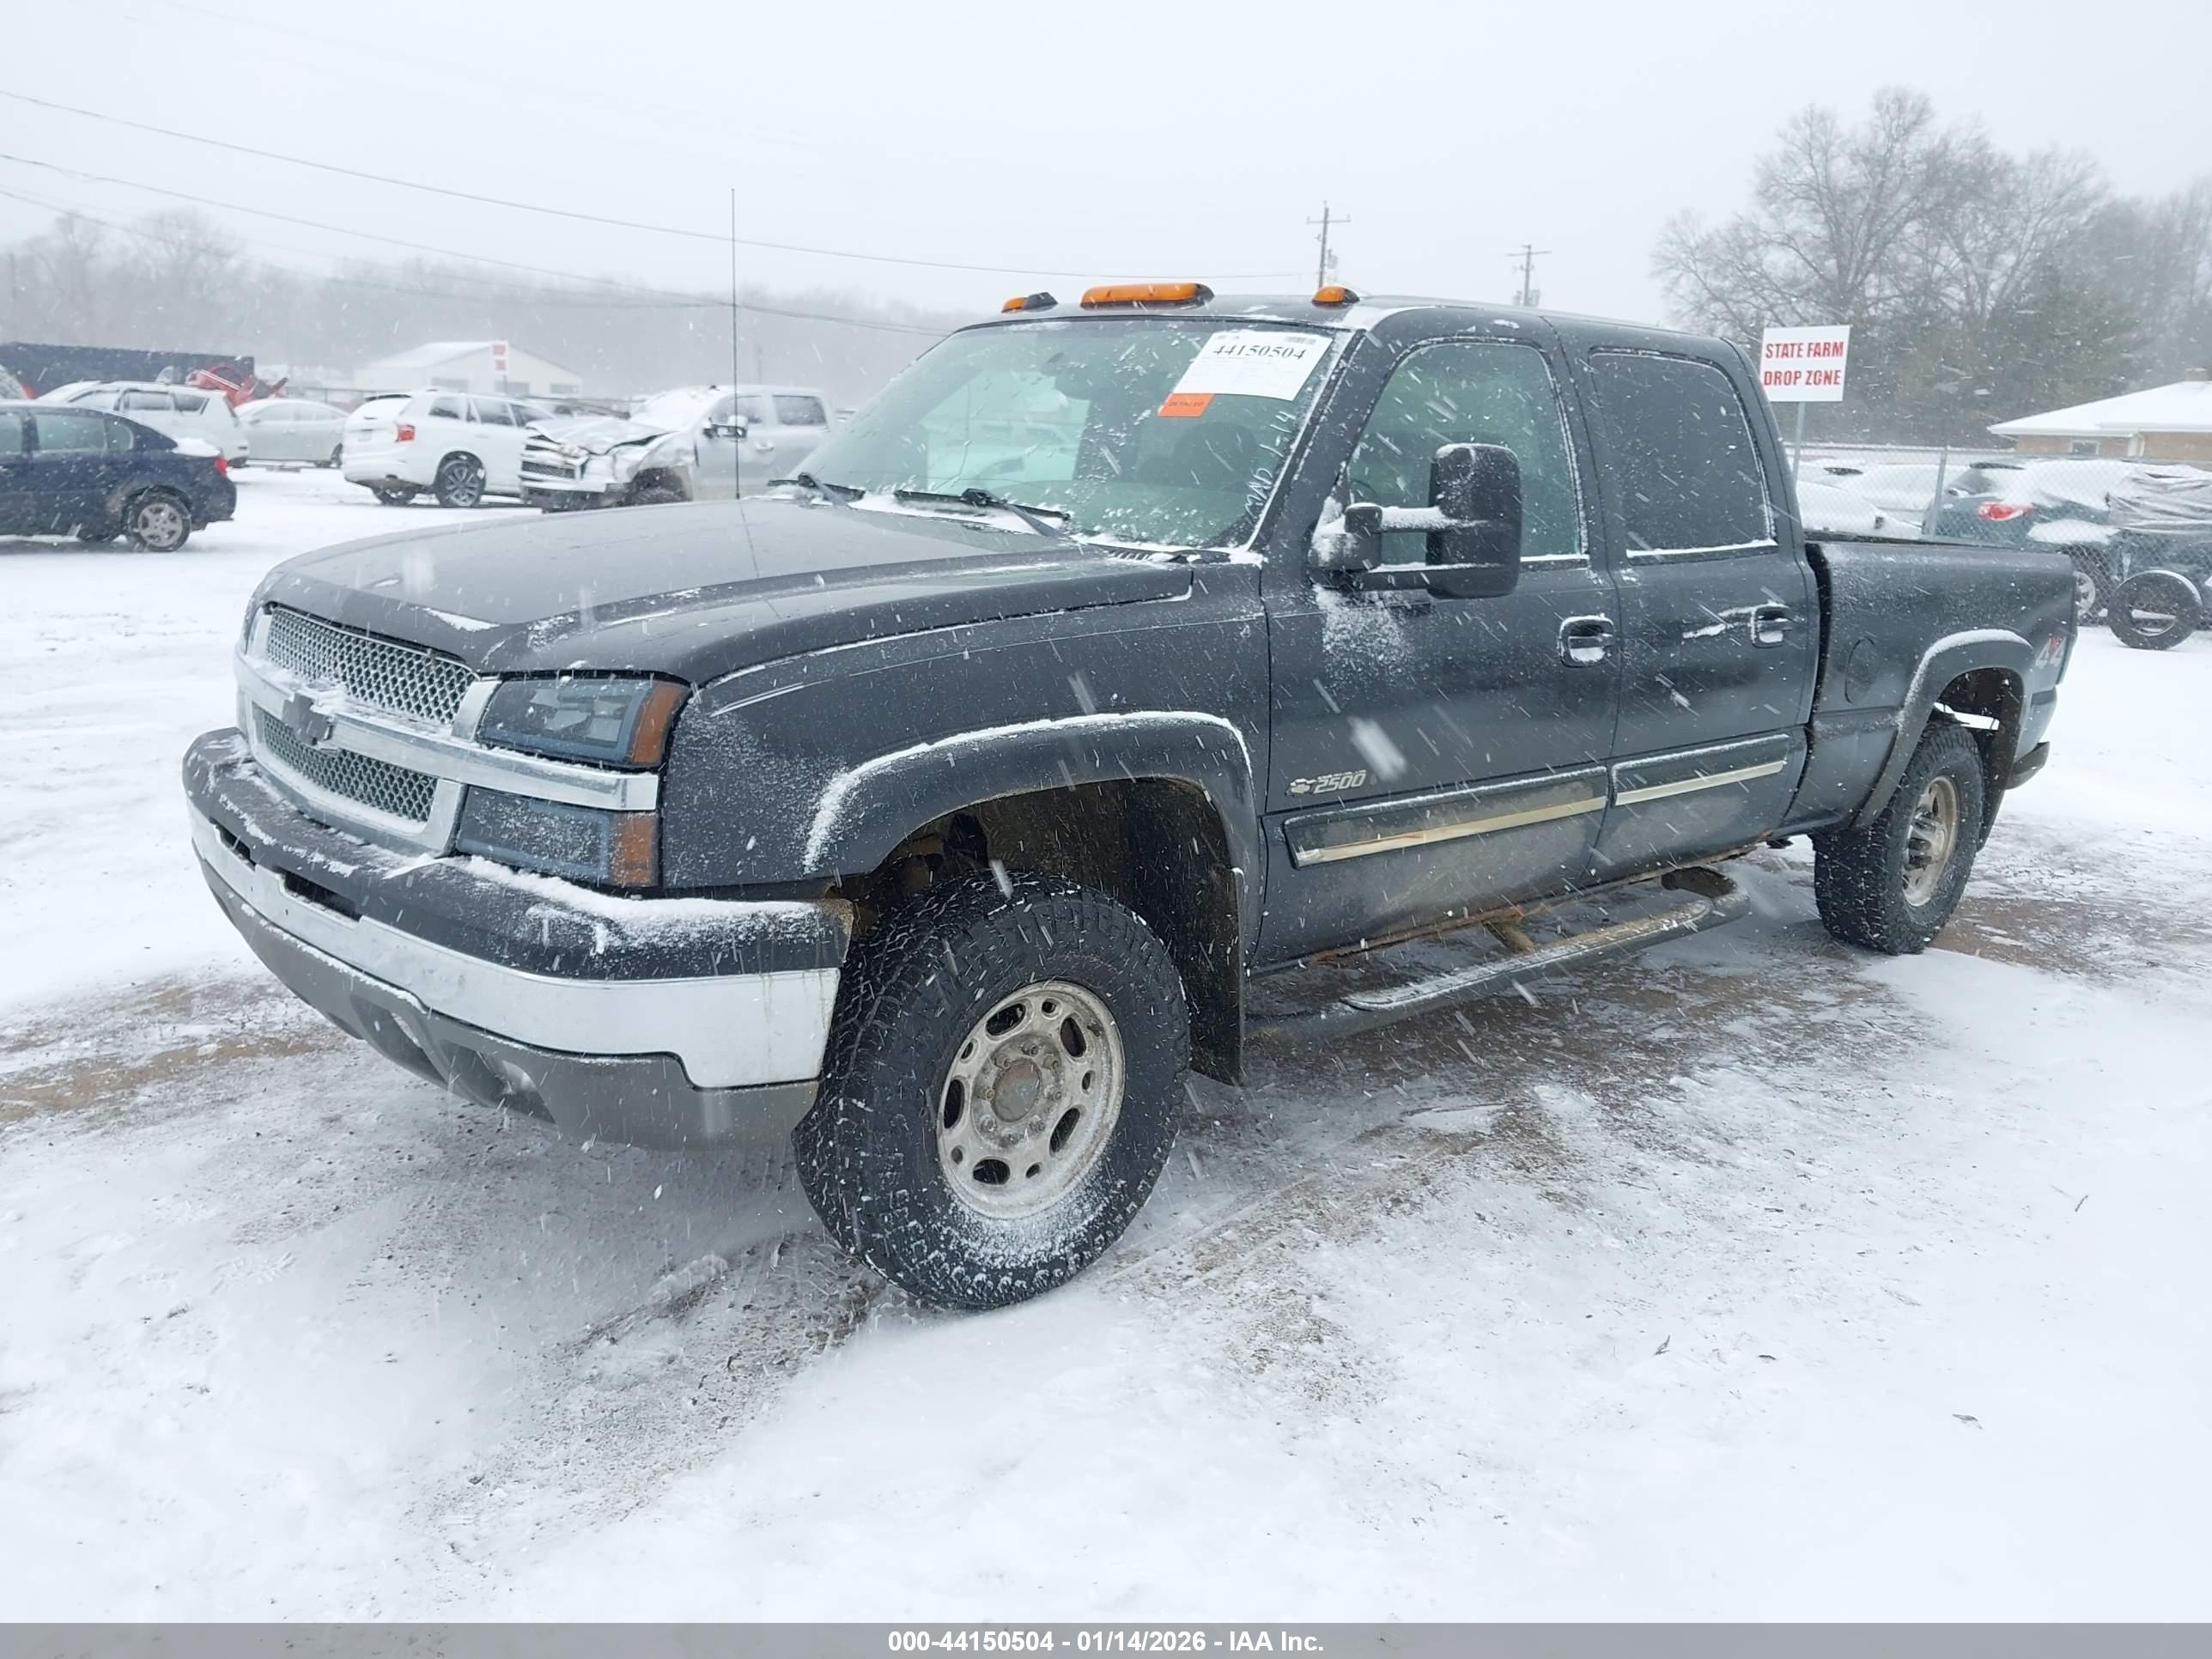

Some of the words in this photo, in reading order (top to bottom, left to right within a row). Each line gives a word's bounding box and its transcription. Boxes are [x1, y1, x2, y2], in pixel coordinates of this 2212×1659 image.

[1212, 344, 1307, 360] 44150504
[1765, 343, 1804, 359] STATE
[1807, 342, 1844, 357] FARM
[1764, 370, 1802, 386] DROP
[1805, 369, 1842, 386] ZONE
[1313, 772, 1367, 794] 2500
